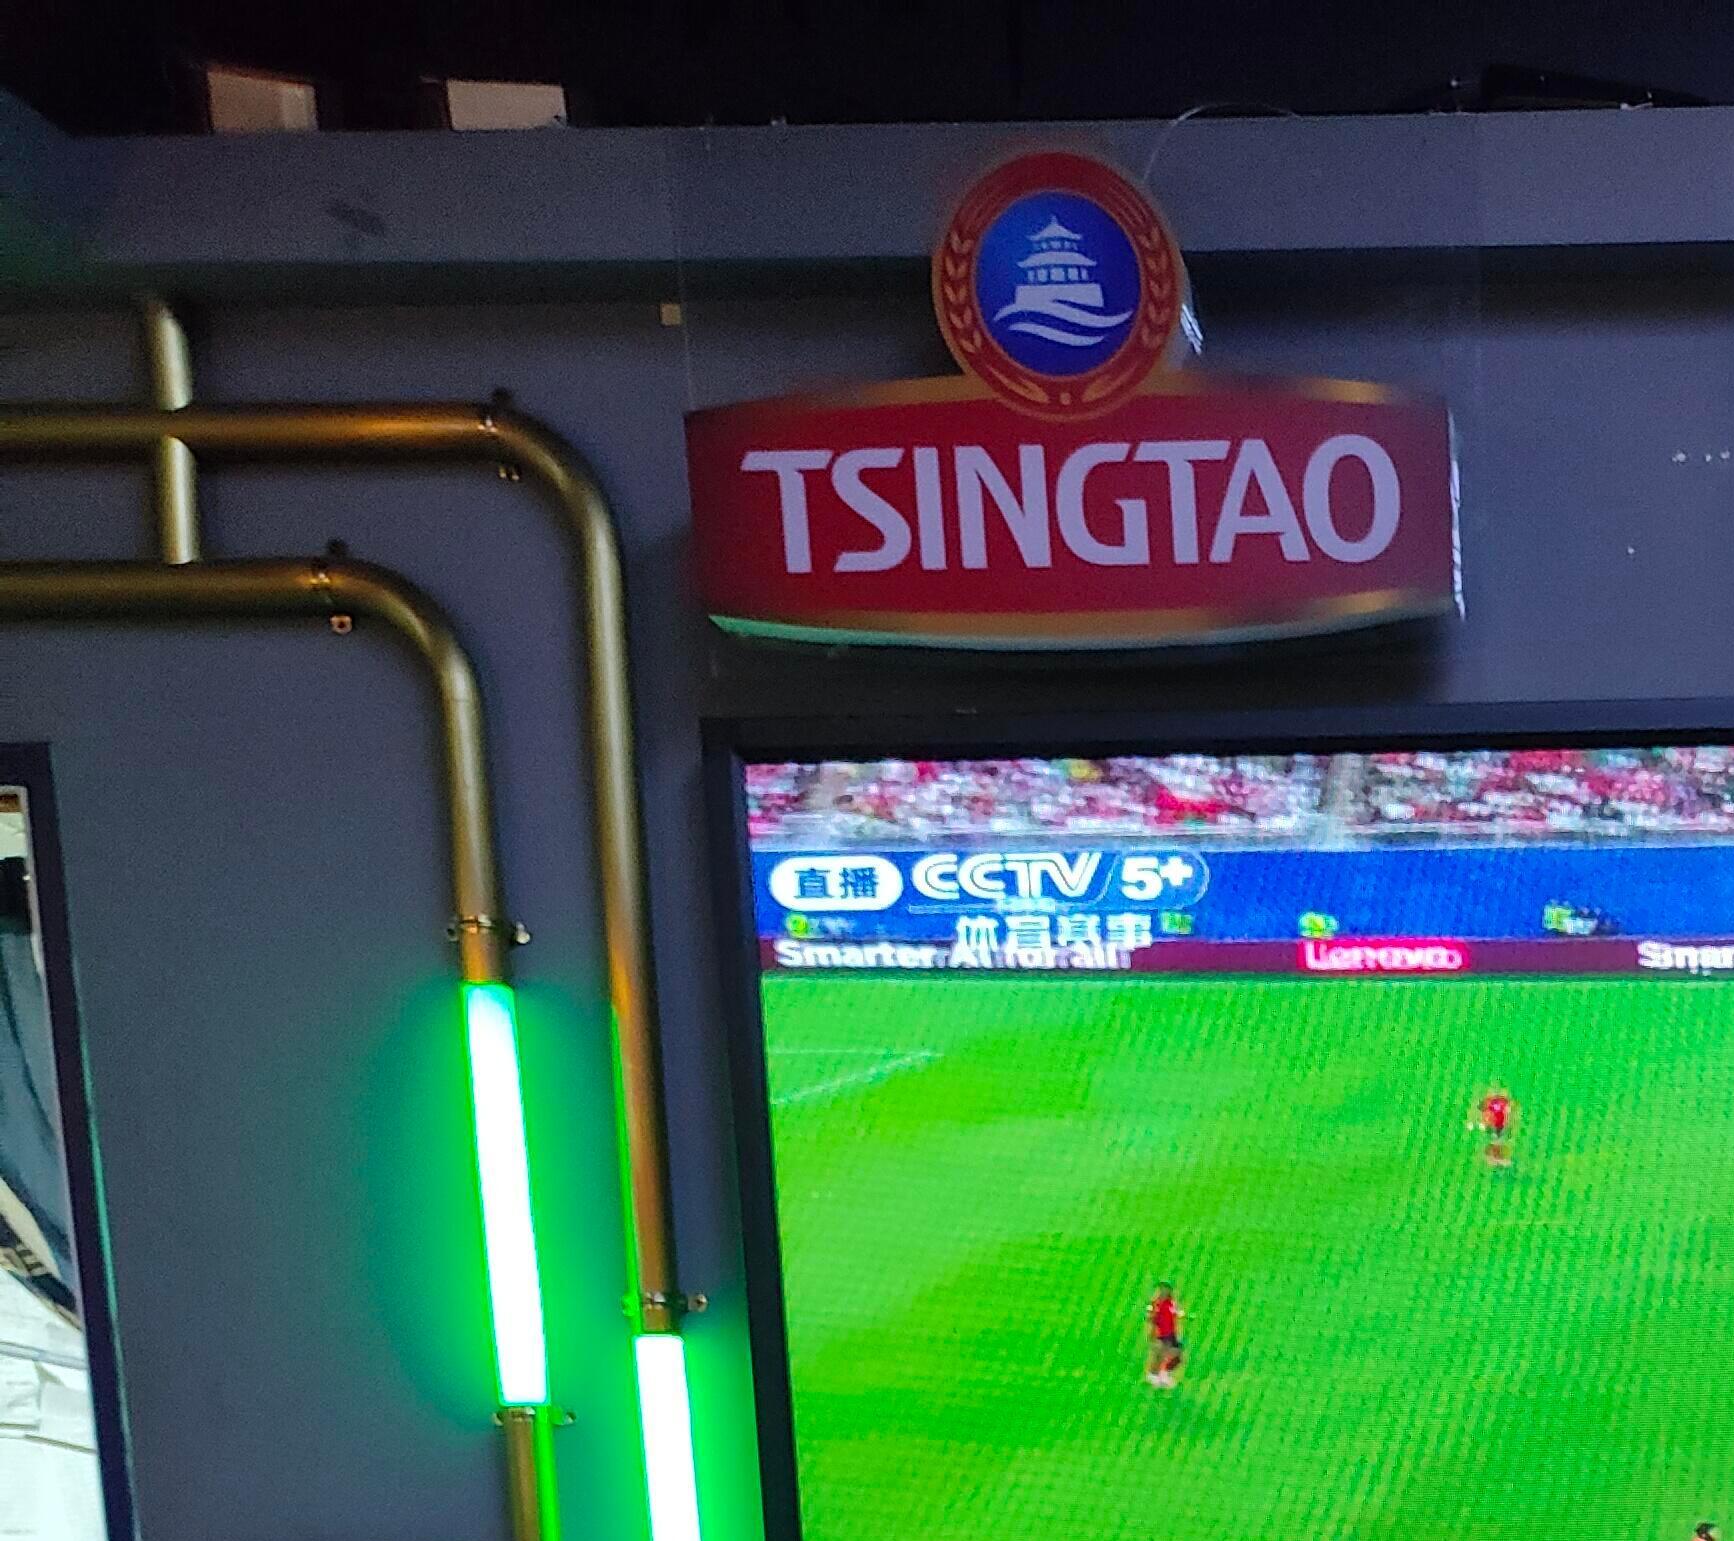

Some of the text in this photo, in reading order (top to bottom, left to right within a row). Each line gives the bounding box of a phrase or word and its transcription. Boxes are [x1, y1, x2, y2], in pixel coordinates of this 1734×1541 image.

[741, 434, 1402, 573] TSINGTAO
[793, 866, 881, 900] 直播
[911, 853, 1194, 901] CCTV 5+
[775, 941, 938, 969] Smarter
